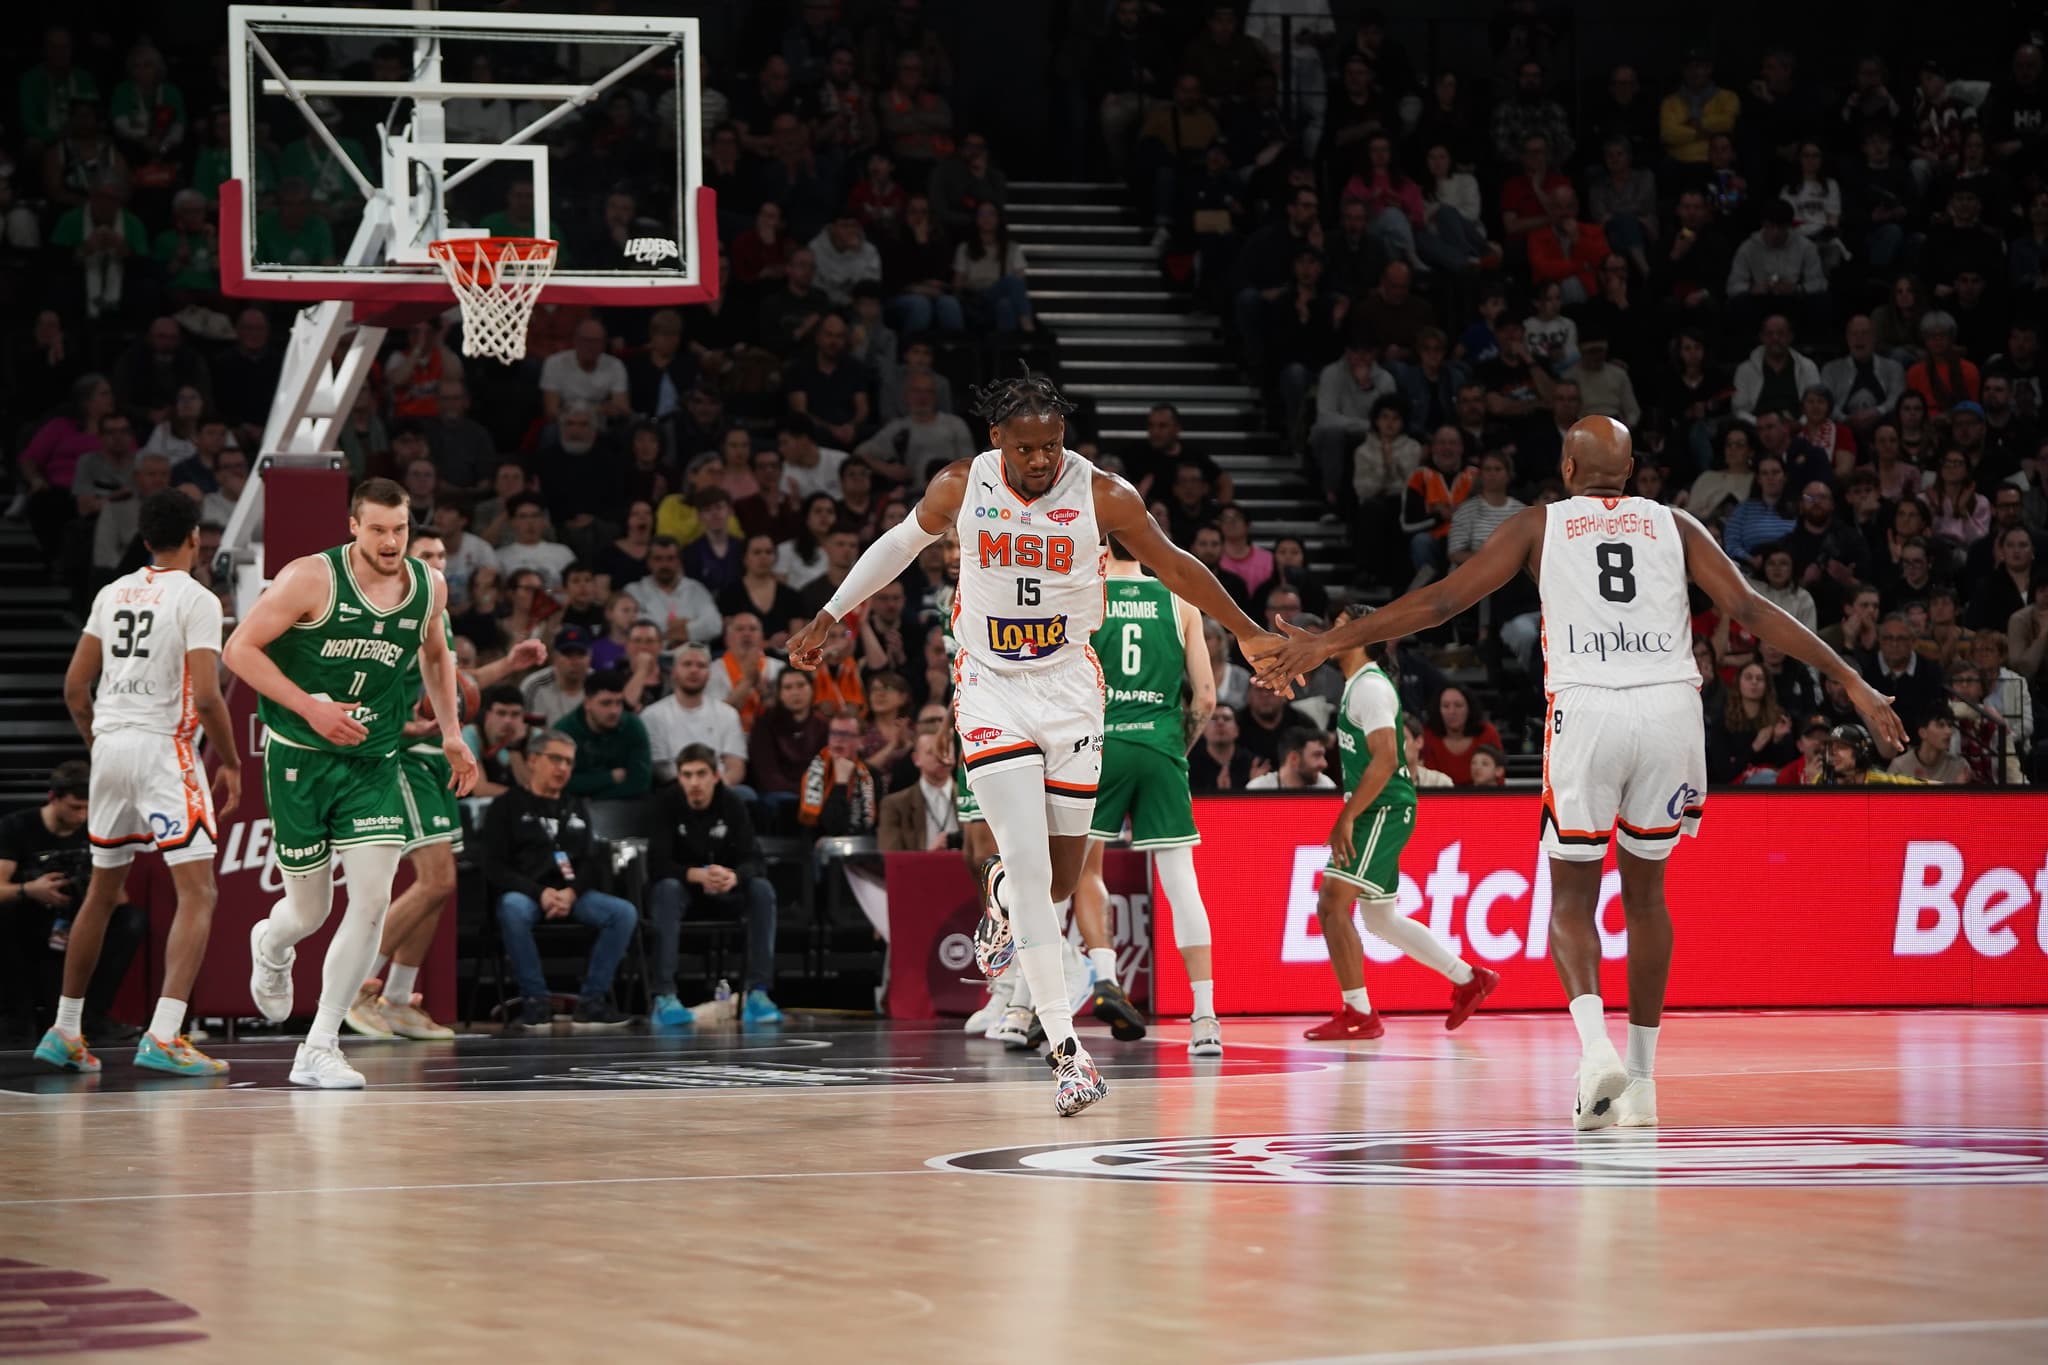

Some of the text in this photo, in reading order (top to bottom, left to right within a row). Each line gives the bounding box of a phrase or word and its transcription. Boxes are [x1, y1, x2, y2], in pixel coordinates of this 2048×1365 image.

[978, 530, 1074, 575] MSB
[1596, 542, 1636, 603] 8
[1017, 577, 1041, 606] 15
[1106, 600, 1159, 619] LACOMBE
[112, 610, 154, 658] 32
[989, 614, 1065, 650] Loué
[1122, 623, 1142, 676] 6
[1569, 621, 1672, 662] Laplace
[348, 671, 368, 696] 11
[1115, 690, 1164, 704] PAPREC
[1555, 710, 1563, 734] 8
